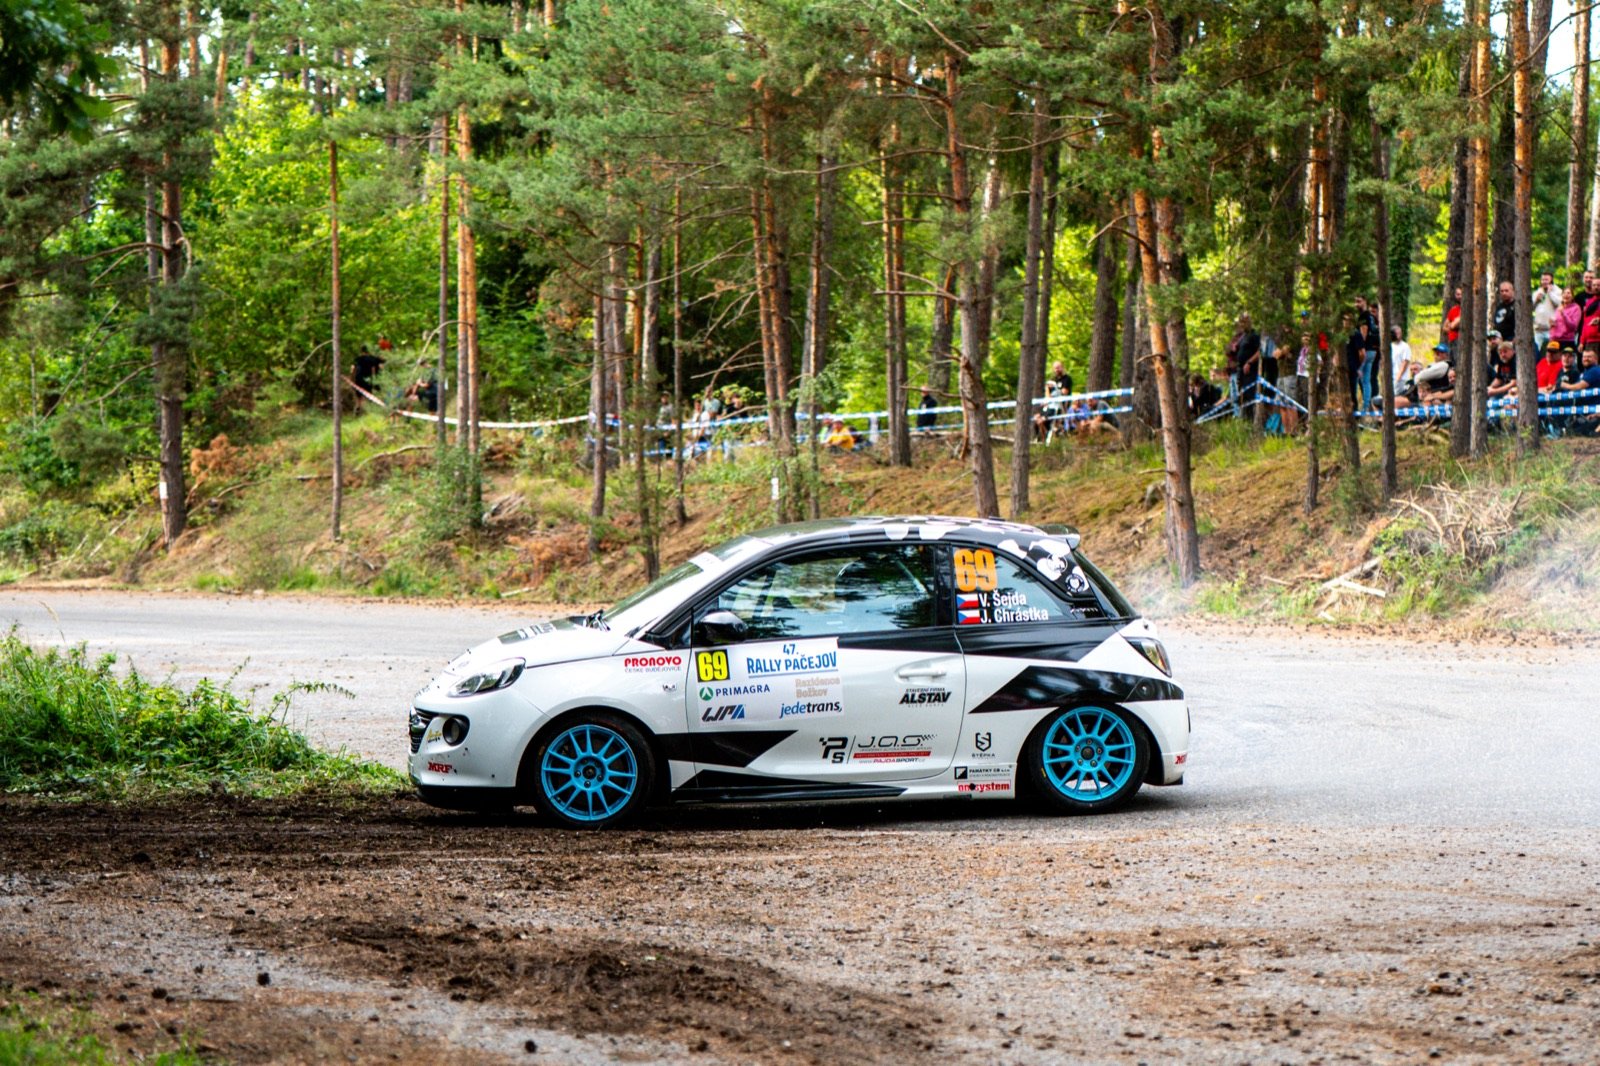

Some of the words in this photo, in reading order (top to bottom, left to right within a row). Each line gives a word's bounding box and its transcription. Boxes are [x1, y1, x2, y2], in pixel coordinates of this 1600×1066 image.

[953, 548, 998, 592] 69
[978, 593, 991, 607] V.
[993, 589, 1027, 608] Šejda
[980, 608, 992, 624] J.
[994, 607, 1049, 623] Chrástka
[782, 643, 799, 655] 47.
[624, 656, 682, 667] PRONOVO
[697, 651, 728, 681] 69
[746, 657, 781, 674] RALLY
[784, 651, 837, 671] PAČEJOV
[715, 684, 770, 697] PRIMAGRA
[899, 691, 952, 705] ALSTAV
[427, 762, 453, 774] MRF
